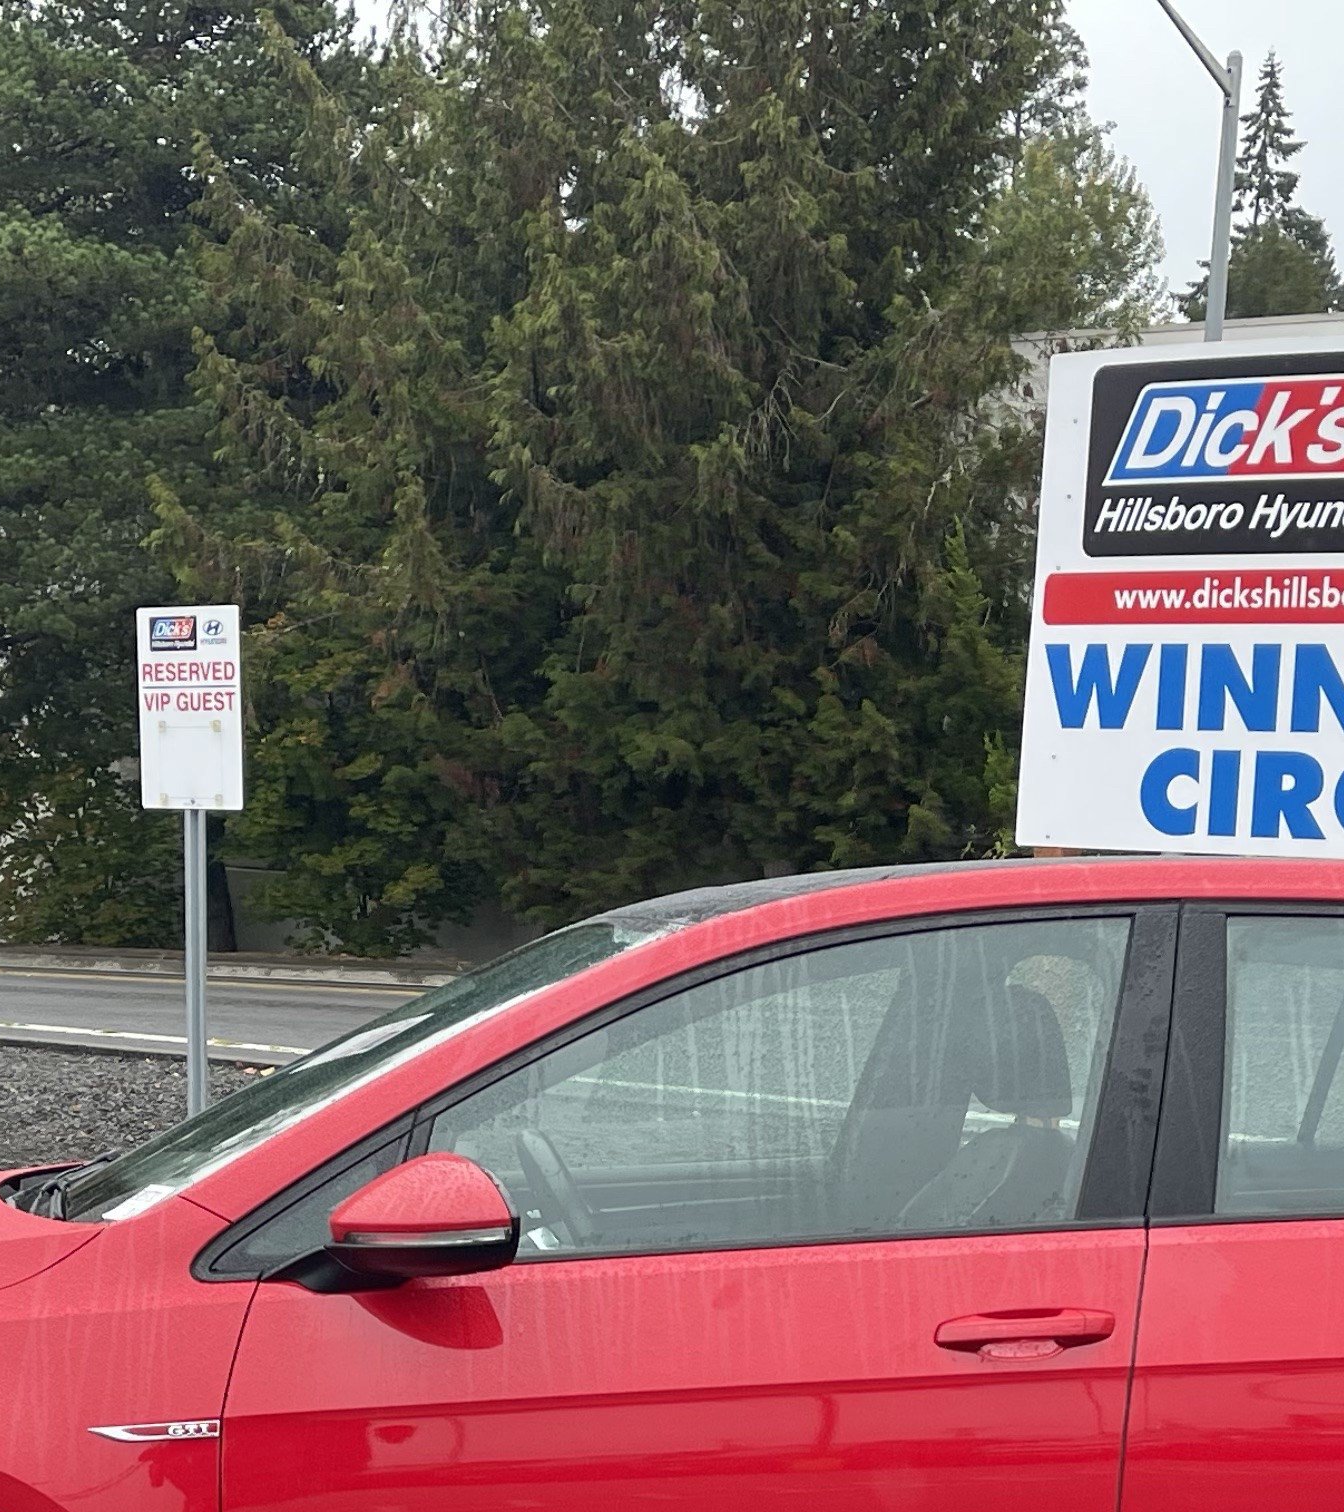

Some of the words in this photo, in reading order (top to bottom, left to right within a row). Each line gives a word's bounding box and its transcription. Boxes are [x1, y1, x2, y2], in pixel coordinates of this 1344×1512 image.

[1094, 497, 1244, 533] Hillsboro
[142, 661, 235, 682] RESERVED
[144, 693, 171, 712] VIP
[176, 691, 236, 712] GUEST
